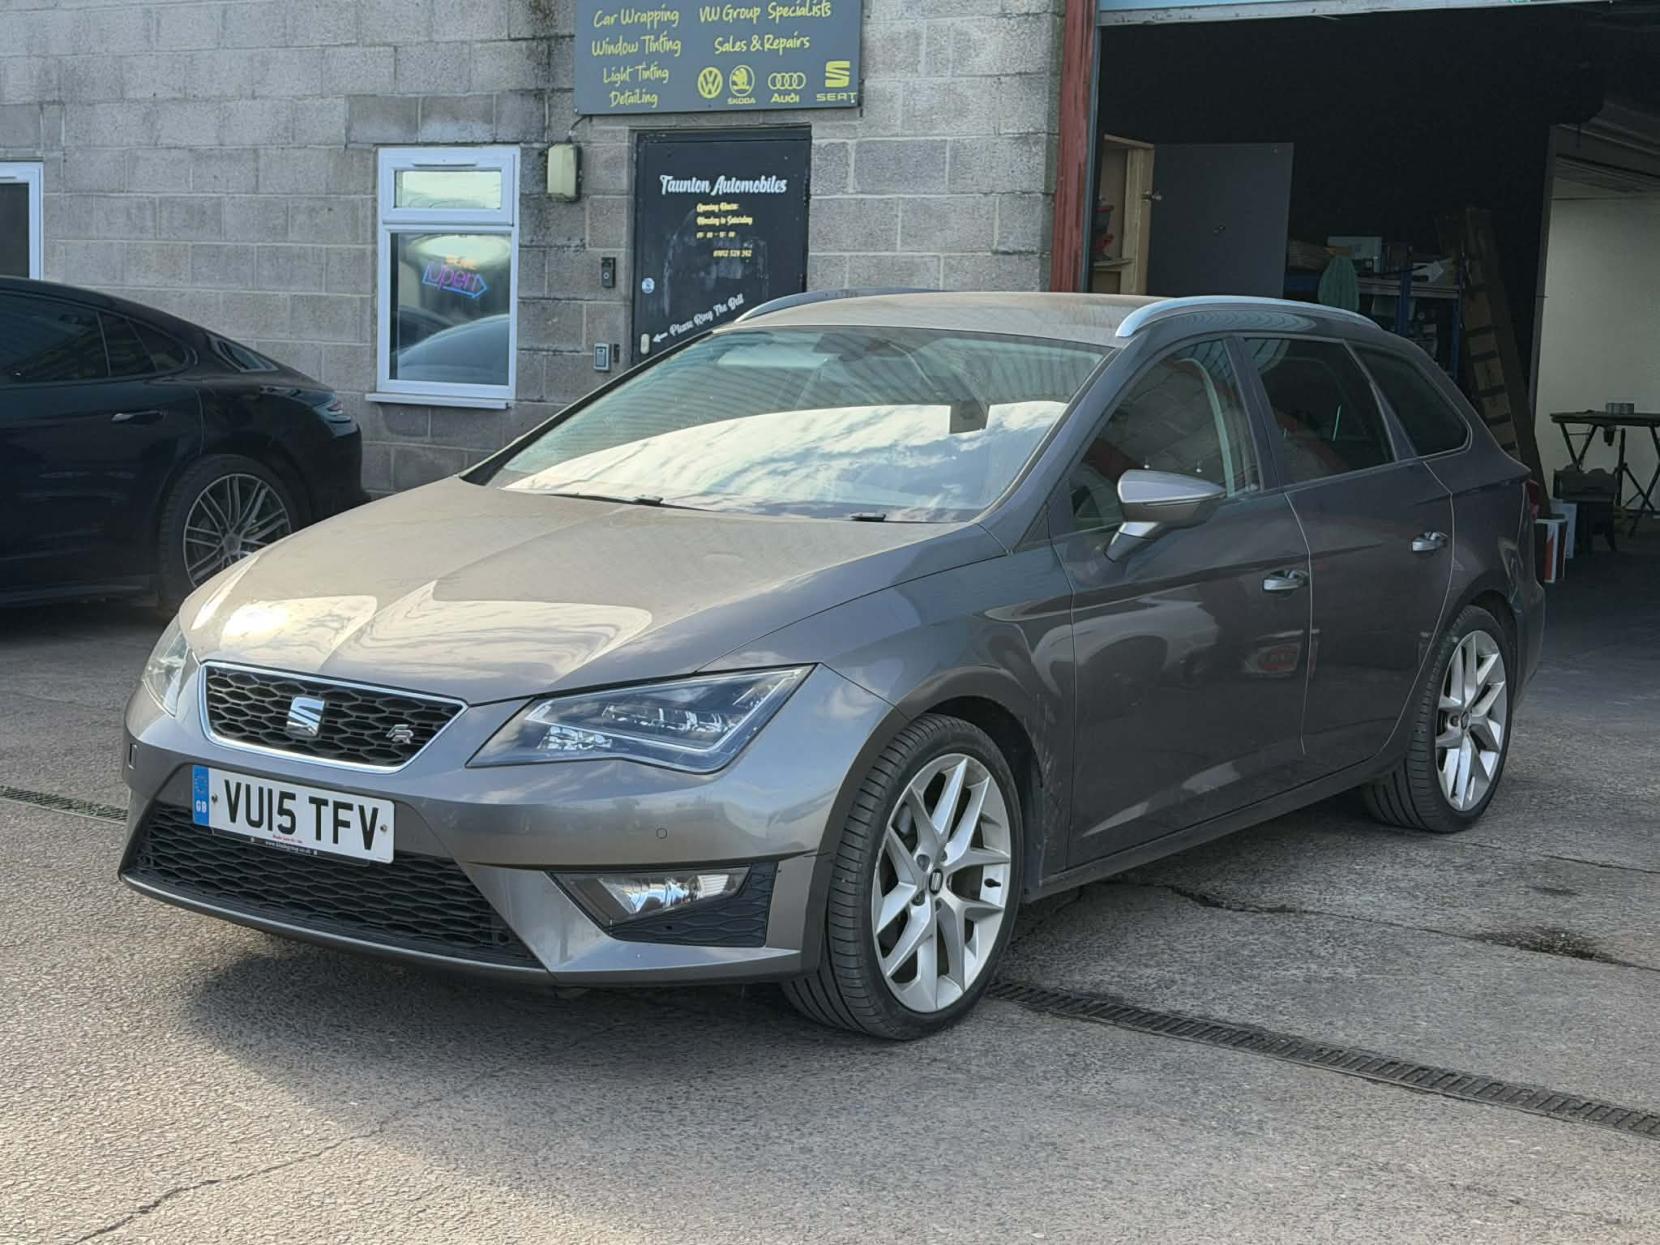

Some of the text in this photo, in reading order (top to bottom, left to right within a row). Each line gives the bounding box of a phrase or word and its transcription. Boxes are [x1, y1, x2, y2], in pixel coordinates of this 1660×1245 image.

[593, 3, 679, 30] Car Wrapping
[723, 4, 761, 24] Group
[768, 0, 831, 24] Specialists
[592, 30, 681, 57] Window Tinting
[714, 31, 810, 56] Sales & Repairs
[603, 61, 669, 87] Light Tinting
[609, 89, 658, 108] Detailing
[816, 92, 857, 102] SEAT
[659, 174, 788, 196] Taunton Automobiles
[693, 311, 714, 326] Ring
[713, 303, 728, 316] The
[728, 293, 744, 310] Bell
[224, 779, 379, 851] VU15 TFV
